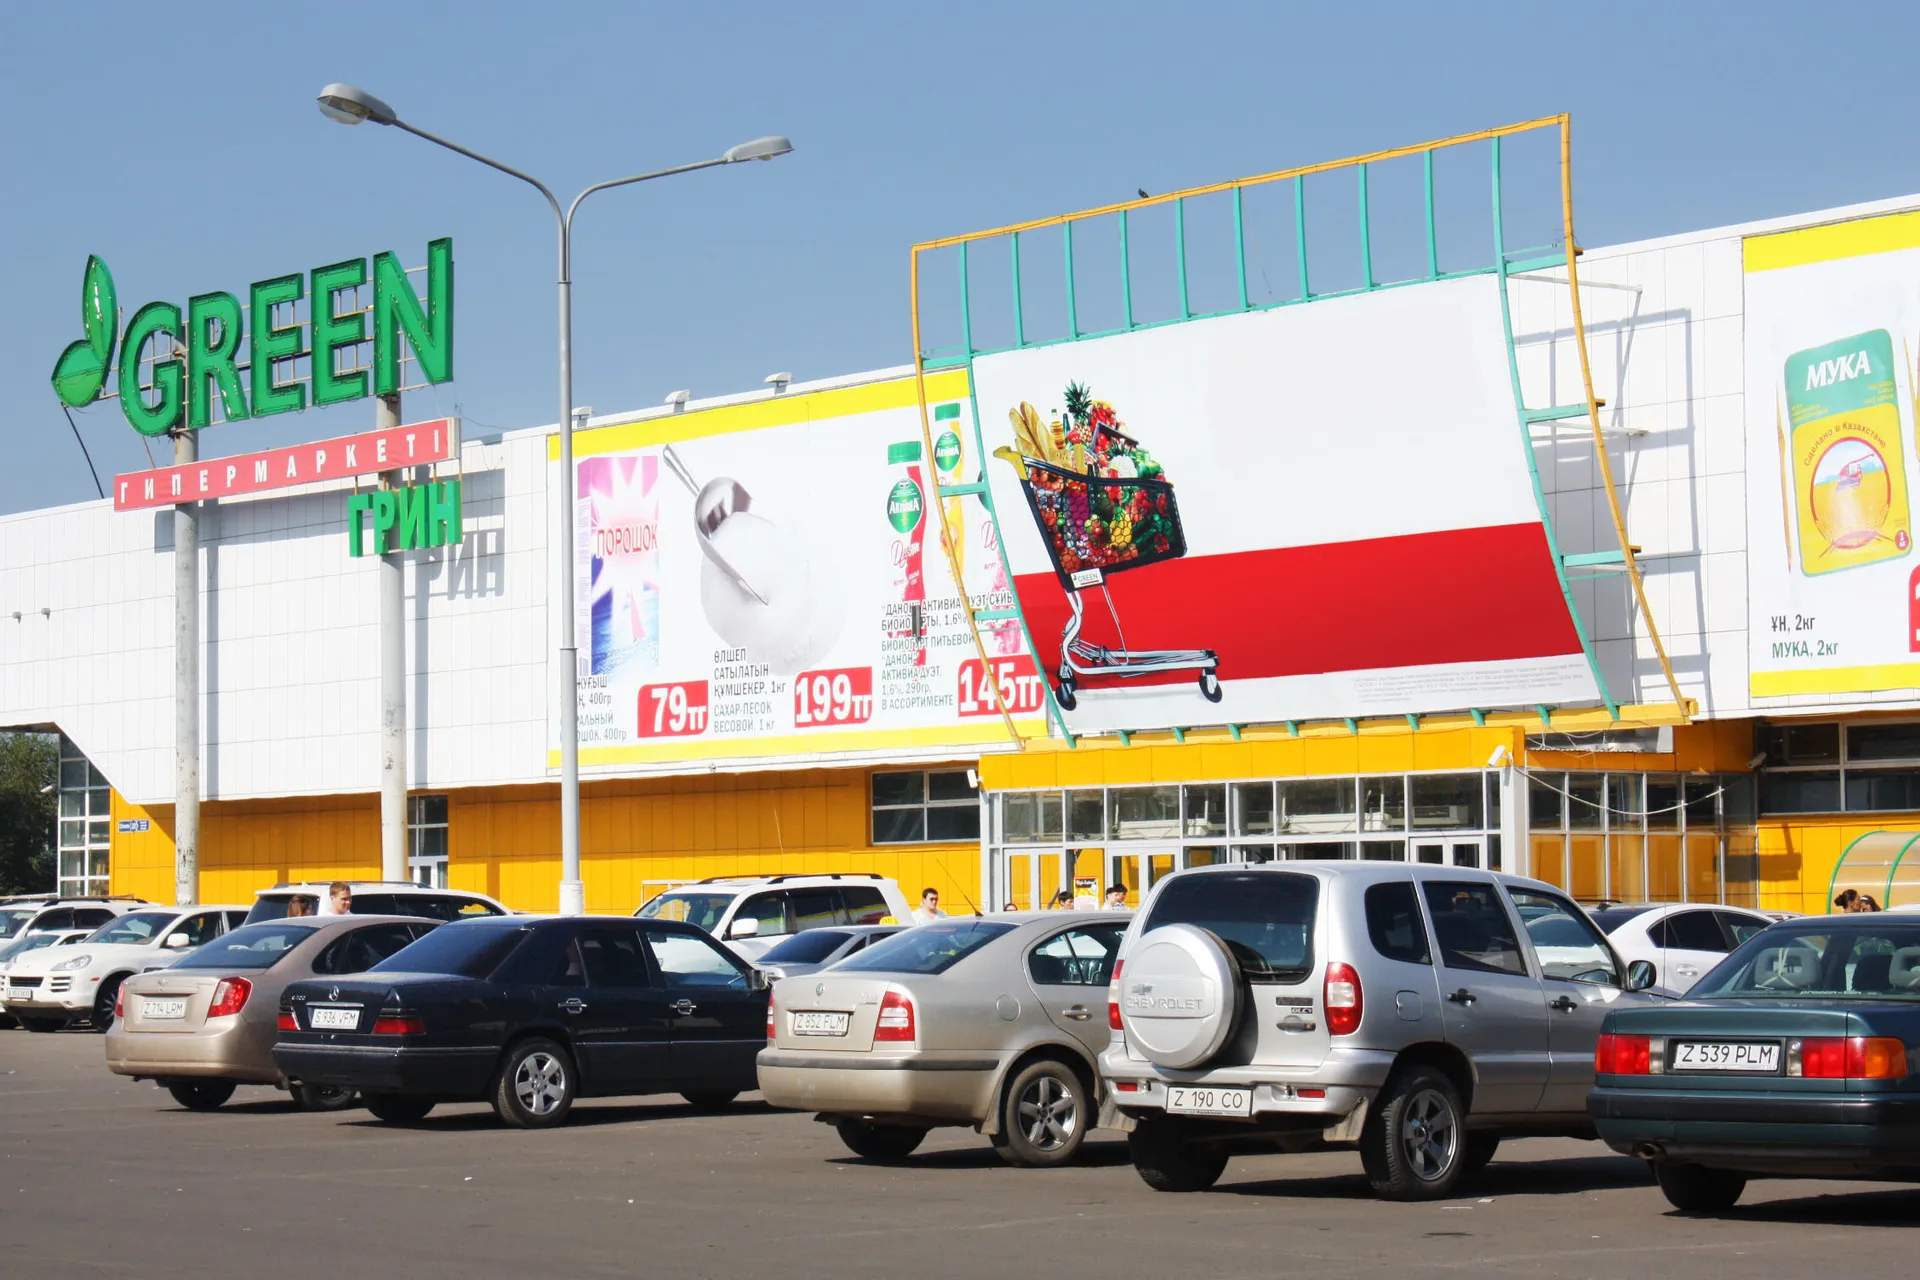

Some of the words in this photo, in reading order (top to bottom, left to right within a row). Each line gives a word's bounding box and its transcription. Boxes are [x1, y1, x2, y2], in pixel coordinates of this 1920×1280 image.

[118, 237, 453, 437] GREEN
[1805, 350, 1872, 392] МУКА
[120, 430, 440, 504] ГИПЕРМАРКЕТІ
[348, 480, 463, 557] ГРИН
[597, 523, 658, 557] ПОРОШОК
[922, 598, 961, 612] АКТИВИА
[967, 594, 987, 608] УЭТ
[881, 613, 941, 631] БИОЙОРТЫ,
[1795, 614, 1815, 631] 2кг
[714, 648, 746, 663] ӨЛШЕП
[1772, 640, 1813, 660] МУКА,
[1817, 639, 1838, 656] 2кг
[714, 664, 769, 680] САТЫЛАТЫН
[771, 680, 786, 694] 1кг
[960, 661, 1042, 713] 145тг
[588, 693, 612, 706] 400гр
[796, 673, 872, 724] 199тг
[881, 699, 887, 710] В
[889, 694, 953, 710] АССОРТИМЕНТЕ
[651, 685, 707, 734] 79тг
[714, 701, 772, 717] САХАР-ПЕСОК
[759, 719, 764, 731] 1
[766, 720, 776, 731] кг
[604, 728, 627, 741] 400гр
[144, 1002, 150, 1014] Z
[1126, 997, 1203, 1011] CHEVROLET
[315, 1012, 321, 1023] S
[797, 1014, 804, 1028] Z
[823, 1014, 845, 1030] FLM
[1682, 1045, 1694, 1062] Z
[1700, 1045, 1730, 1063] 539
[1736, 1045, 1773, 1064] PLM
[1174, 1090, 1184, 1107] Z
[1191, 1091, 1214, 1108] 190
[1221, 1092, 1243, 1109] CO
